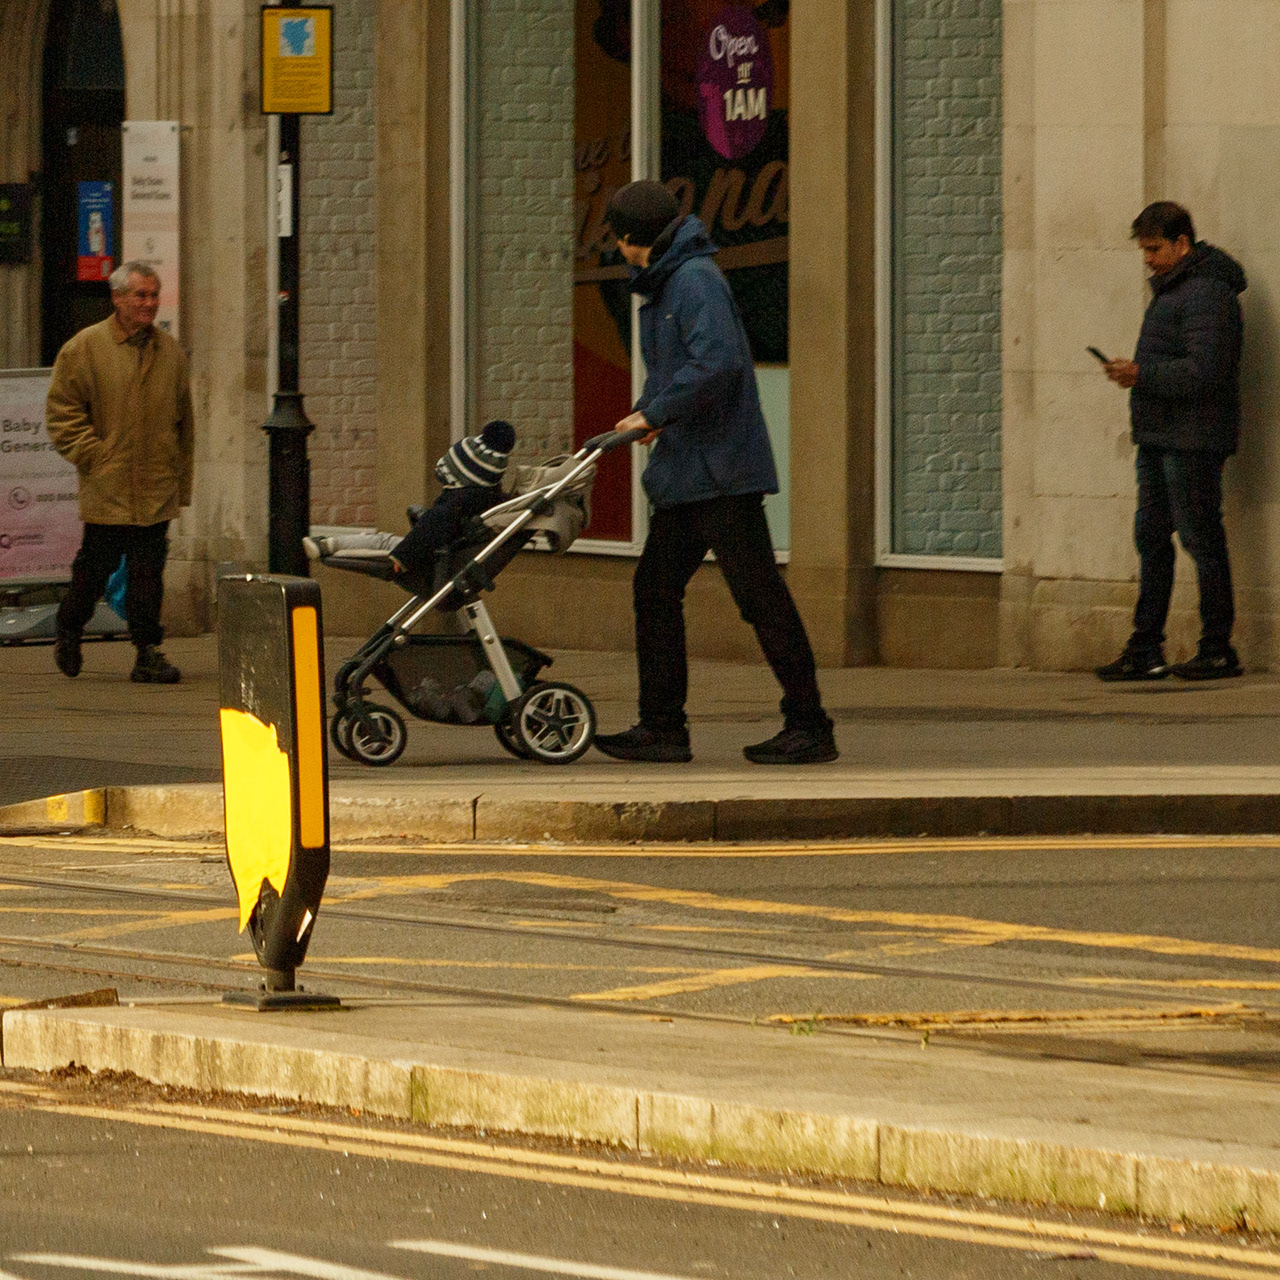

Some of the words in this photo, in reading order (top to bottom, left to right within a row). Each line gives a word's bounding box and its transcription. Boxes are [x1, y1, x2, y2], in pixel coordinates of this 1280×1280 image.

[710, 24, 759, 68] Open
[724, 88, 767, 121] 1AM
[2, 419, 40, 435] Baby
[0, 440, 57, 453] Genera
